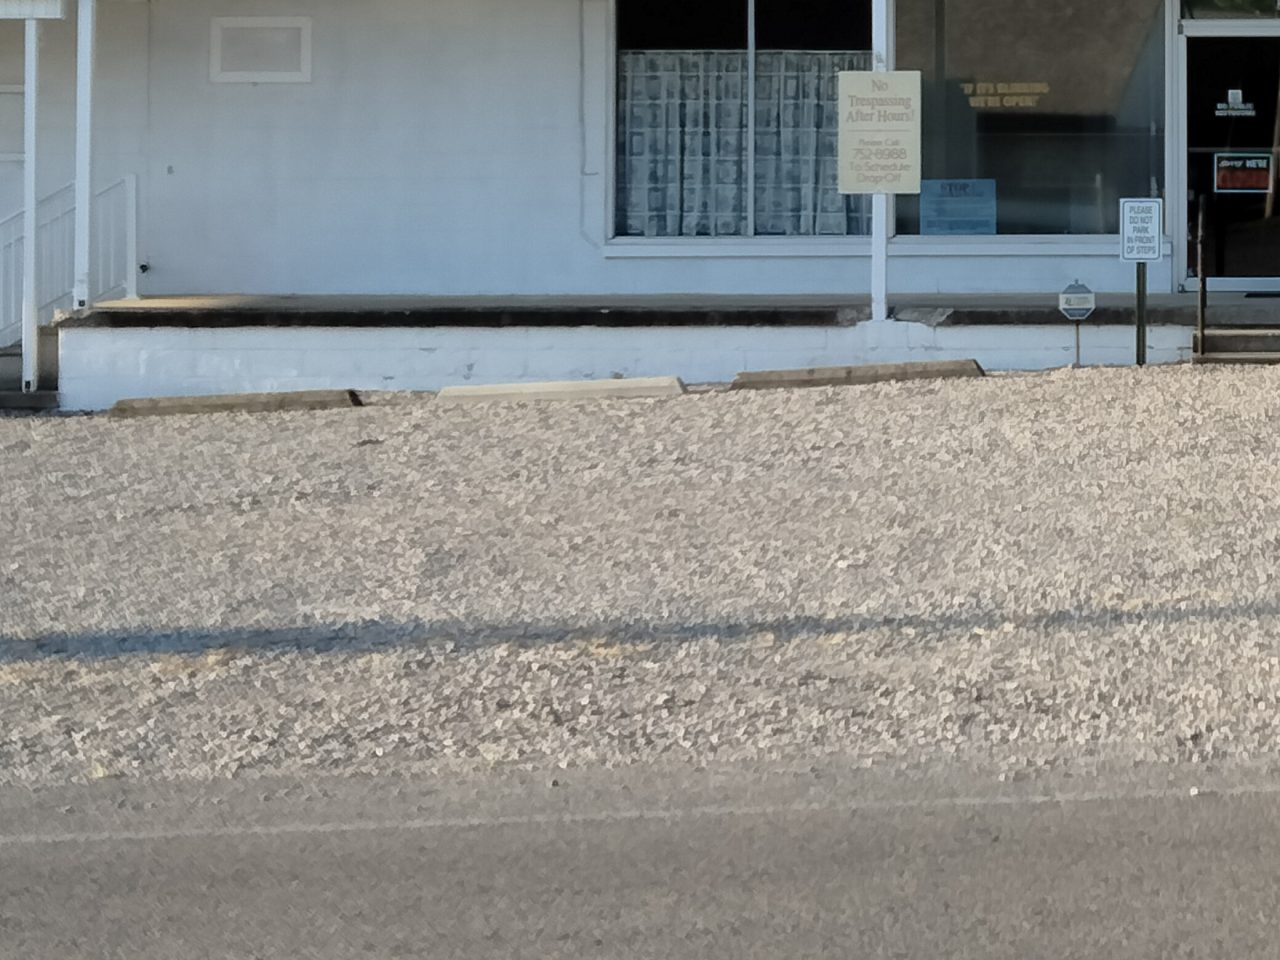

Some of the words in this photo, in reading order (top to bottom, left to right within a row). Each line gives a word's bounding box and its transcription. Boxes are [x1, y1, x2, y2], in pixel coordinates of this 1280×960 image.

[872, 79, 889, 92] No
[848, 94, 913, 110] Trespassing
[846, 109, 875, 123] After
[878, 109, 915, 123] Hours!
[1129, 205, 1153, 215] PLEASE
[1129, 215, 1139, 225] DO
[1140, 215, 1154, 225] NOT
[1132, 225, 1151, 235] PARK
[1135, 235, 1156, 244] FRONT
[1126, 245, 1135, 255] OF
[1136, 245, 1157, 255] STEPS
